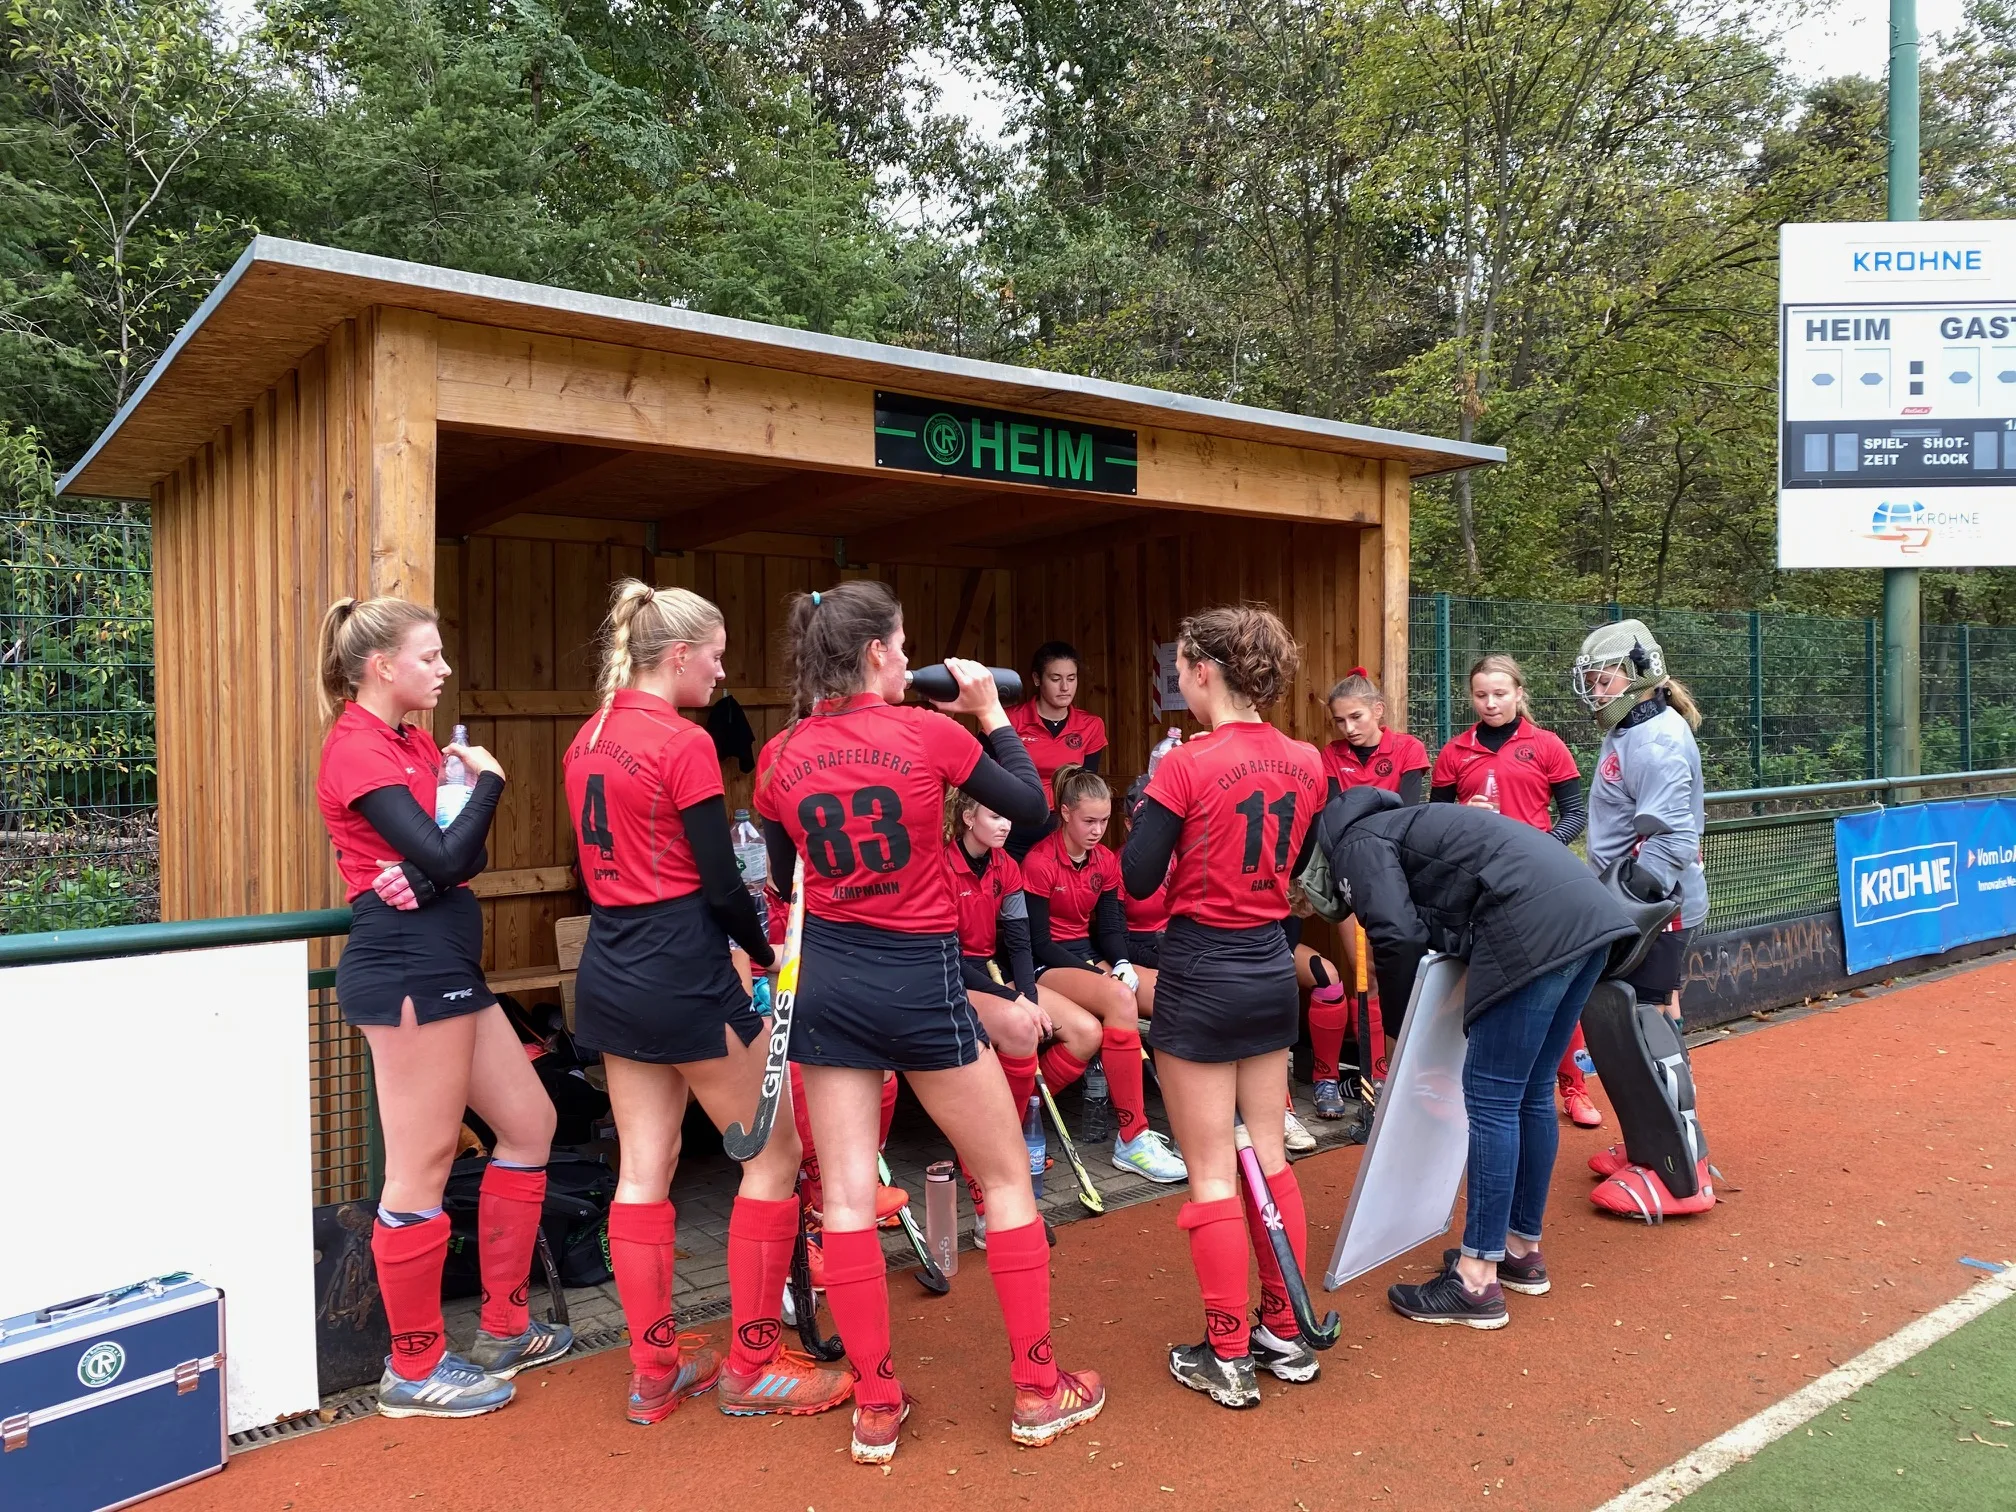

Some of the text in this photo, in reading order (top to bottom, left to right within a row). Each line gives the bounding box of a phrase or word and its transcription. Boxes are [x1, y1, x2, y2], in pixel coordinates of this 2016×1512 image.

[1853, 250, 1982, 271] KROHNE
[1805, 318, 1891, 342] HEIM
[971, 418, 1093, 481] HEIM
[1863, 437, 1909, 450] SPIEL-
[1922, 437, 1970, 449] SHOT-
[1863, 454, 1900, 466] ZEIT
[1923, 453, 1969, 466] CLOCK
[1916, 512, 1980, 525] KROHNE
[780, 748, 913, 793] CLUB RAFFELBERG
[1217, 759, 1315, 791] CLUB RAFFELBERG
[581, 773, 615, 860] 4
[797, 785, 912, 879] 83
[1235, 789, 1298, 875] 11
[882, 861, 896, 870] CR
[1977, 847, 1999, 867] Vom
[831, 881, 900, 900] KEMPMANN
[1250, 879, 1275, 892] GANS
